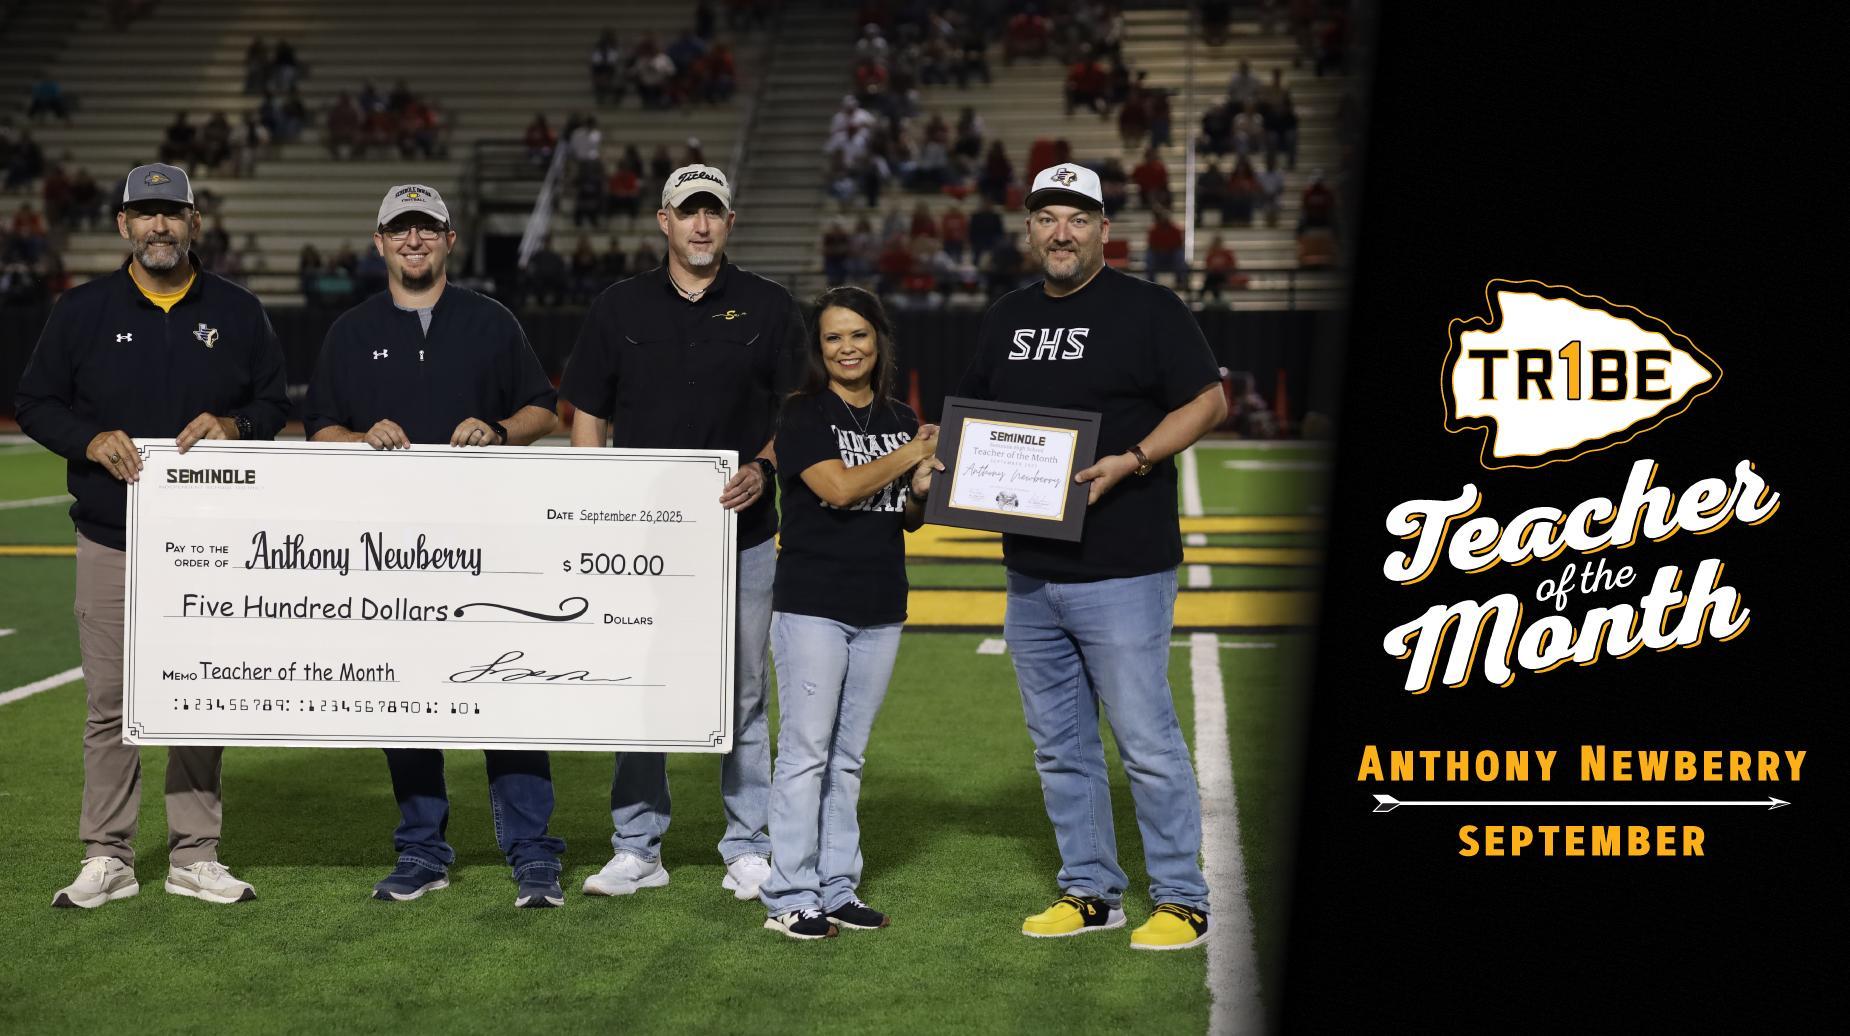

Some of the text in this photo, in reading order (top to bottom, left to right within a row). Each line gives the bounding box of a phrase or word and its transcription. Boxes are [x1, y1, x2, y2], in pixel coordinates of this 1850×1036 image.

[1008, 328, 1090, 361] SHS
[990, 431, 1046, 446] SEMINOLE
[973, 447, 1058, 464] Teacher of the Month
[166, 469, 255, 484] SEMINOLE
[580, 510, 636, 524] September
[639, 511, 683, 523] 26,2025
[245, 531, 482, 576] Anthony Newberry
[174, 559, 210, 567] ORDER
[580, 553, 664, 575] 500.00
[183, 594, 449, 621] Five Hundred Dollars
[199, 662, 272, 680] Teacher
[278, 662, 297, 680] of
[304, 662, 333, 681] the
[340, 663, 395, 681] Month
